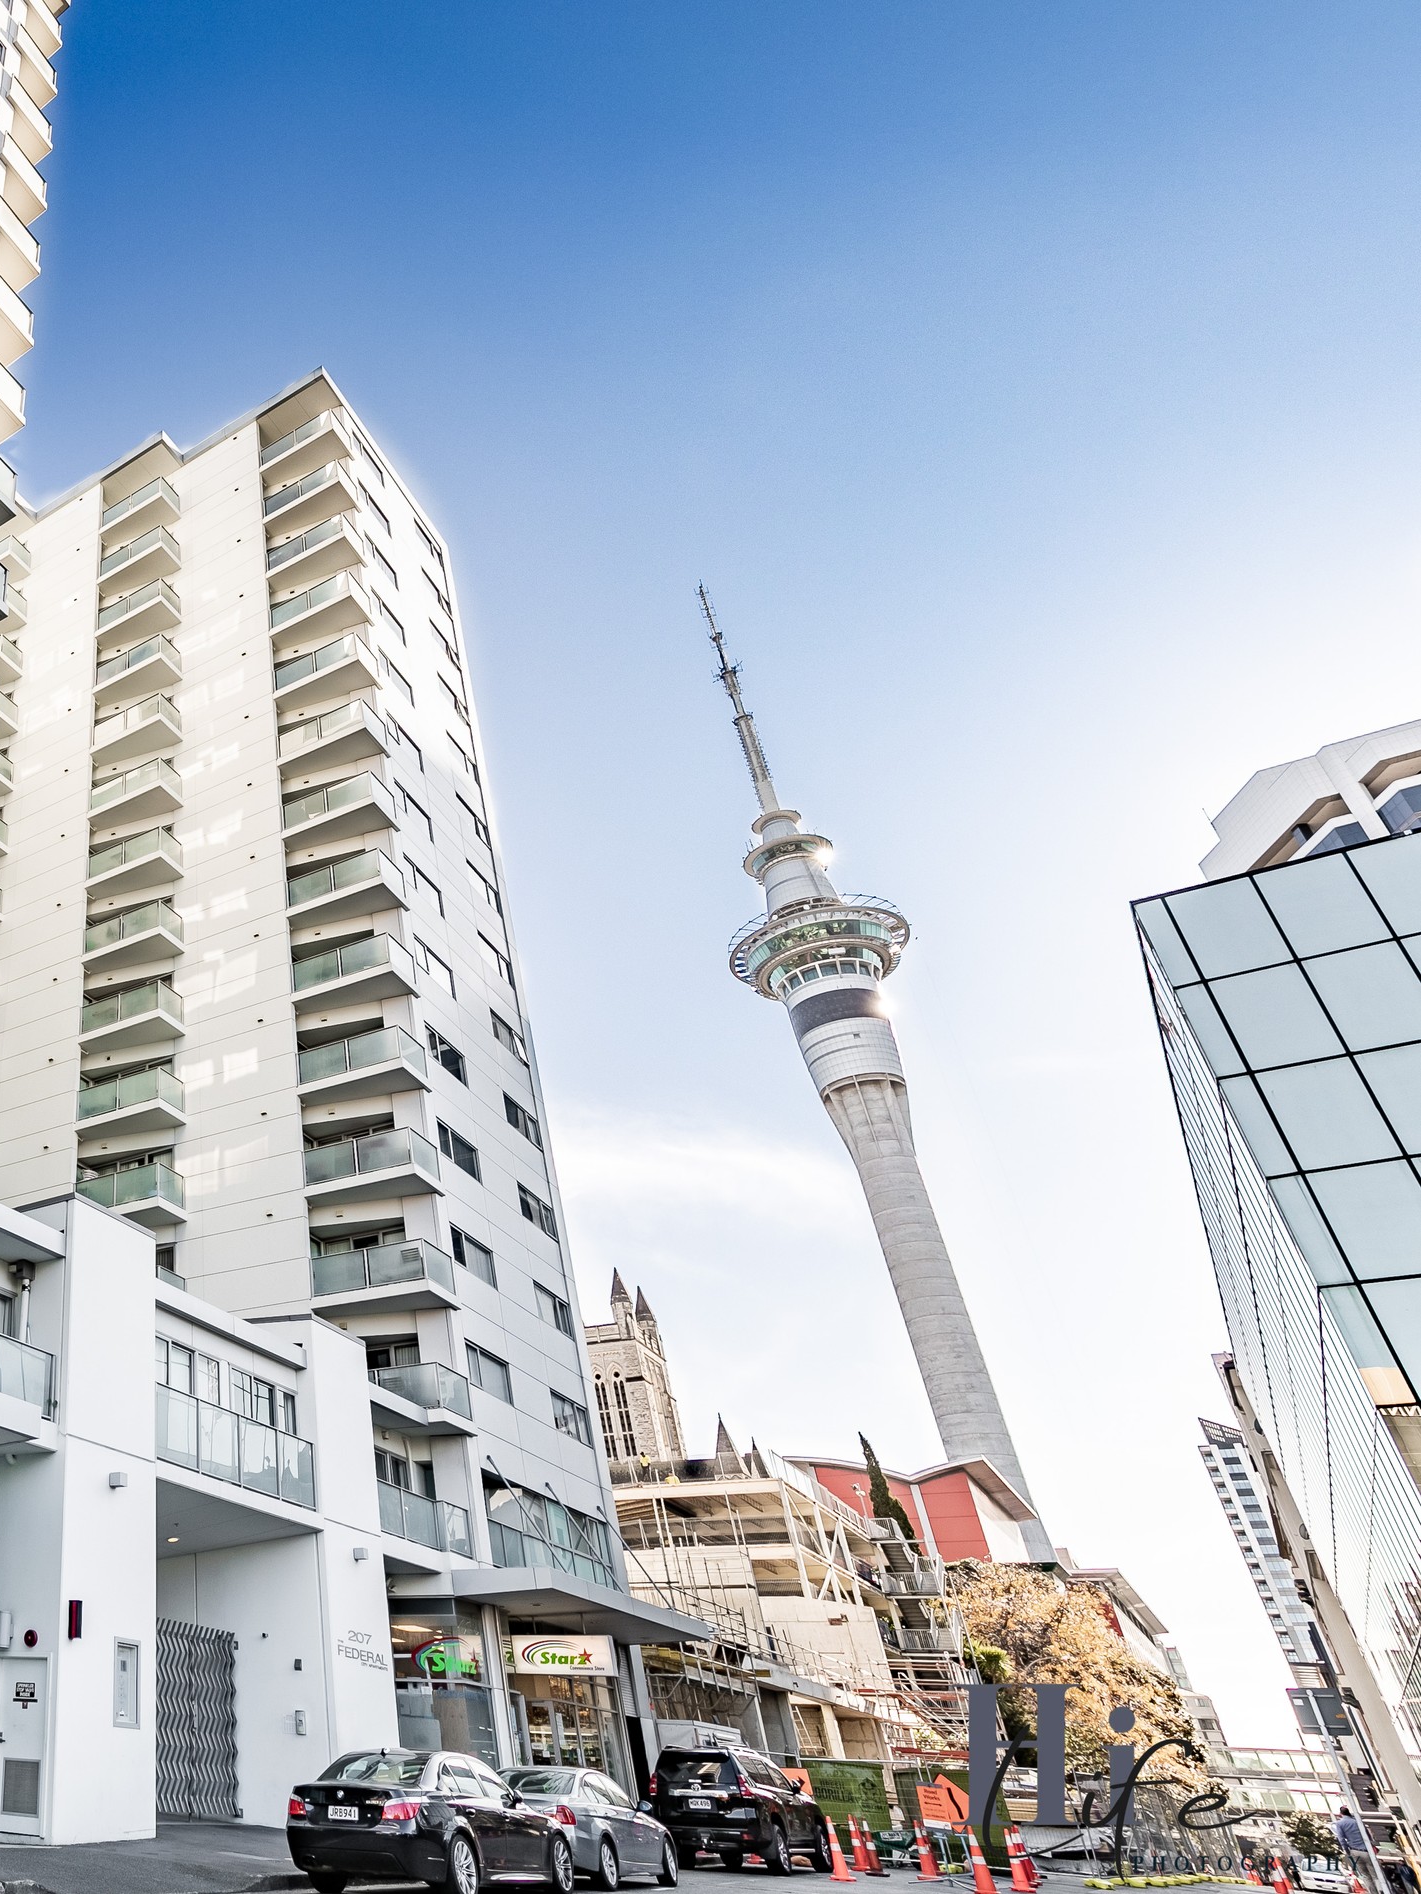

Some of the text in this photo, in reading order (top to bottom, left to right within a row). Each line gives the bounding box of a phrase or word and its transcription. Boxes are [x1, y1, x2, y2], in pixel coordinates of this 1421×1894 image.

[348, 1630, 372, 1645] 207
[337, 1644, 388, 1666] FEDERAL
[540, 1651, 587, 1665] Starz
[329, 1807, 356, 1818] JRB941
